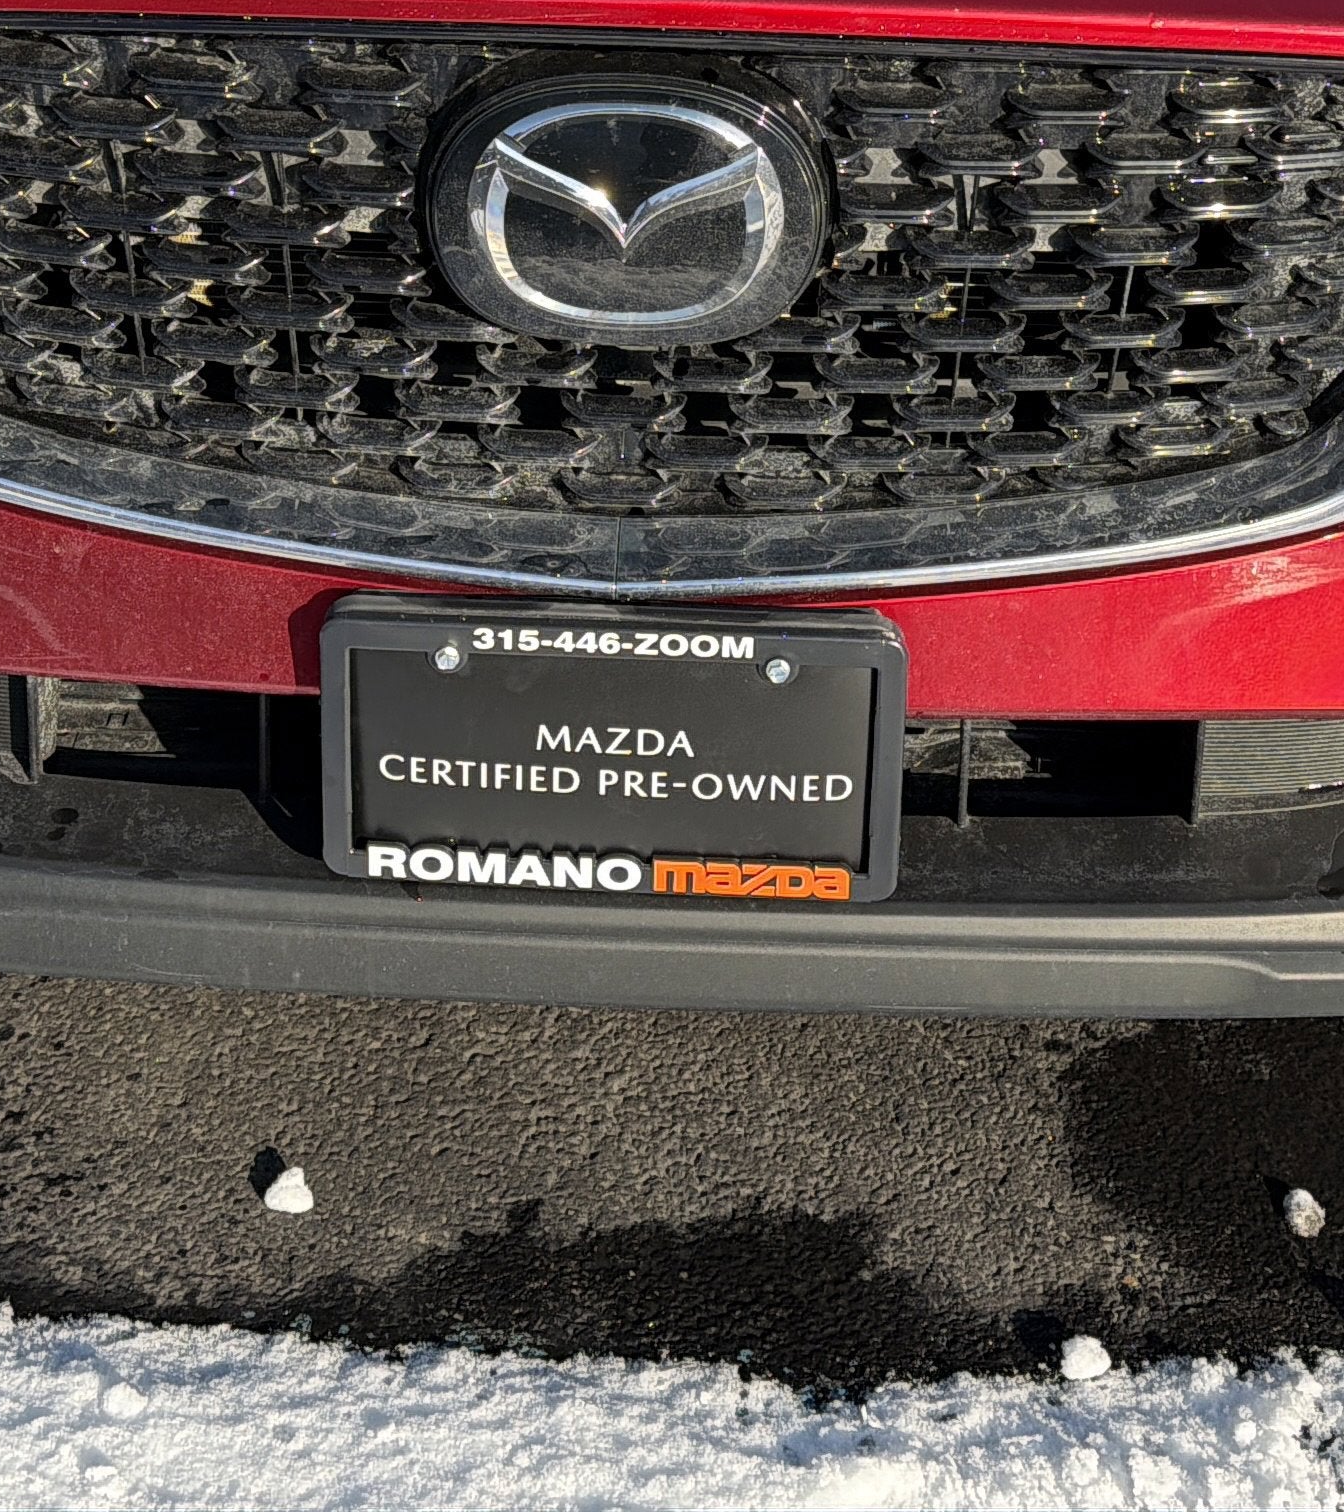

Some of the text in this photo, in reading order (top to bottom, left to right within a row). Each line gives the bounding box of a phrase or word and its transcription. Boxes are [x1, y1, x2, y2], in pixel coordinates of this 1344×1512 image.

[472, 626, 756, 660] 315-446-ZOOM
[536, 724, 695, 758] MAZDA
[379, 754, 854, 803] CERTIFIED PRE-OWNED
[367, 845, 642, 891] ROMANO
